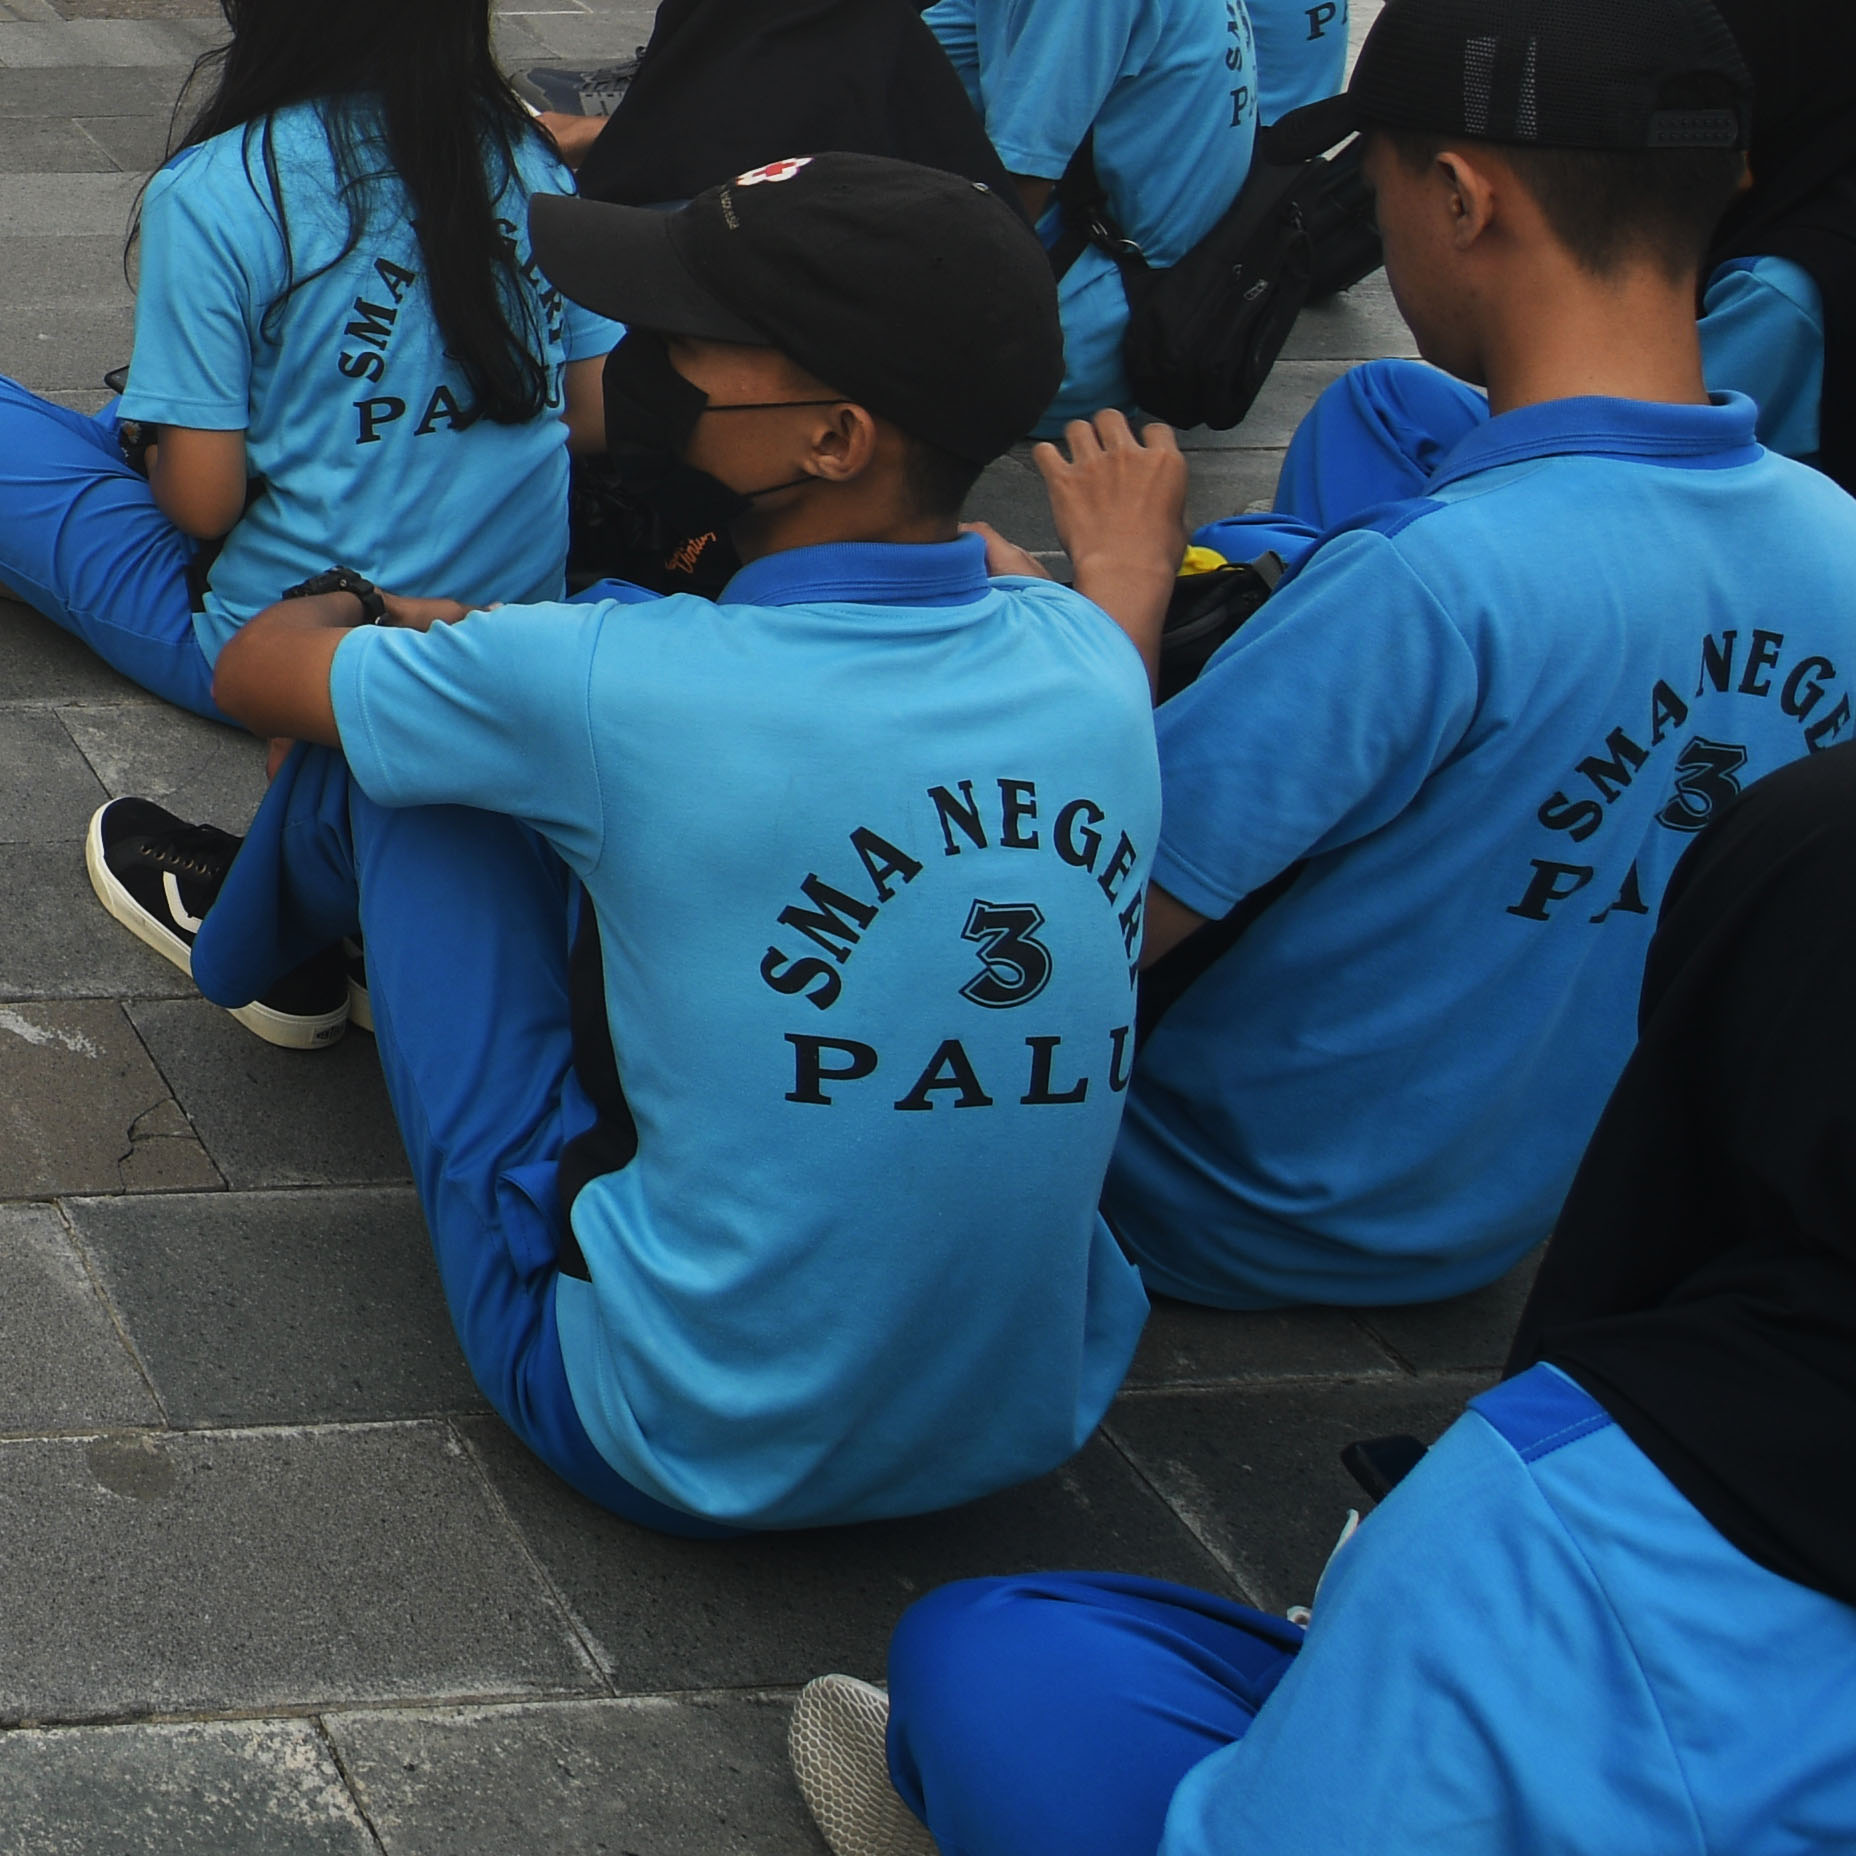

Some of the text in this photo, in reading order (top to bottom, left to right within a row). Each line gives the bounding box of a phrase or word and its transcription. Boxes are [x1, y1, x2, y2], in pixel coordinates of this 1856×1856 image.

[338, 257, 417, 384] SMA
[1538, 629, 1850, 842] SMA NEGE
[1654, 736, 1746, 831] 3
[759, 826, 924, 1011] SMA
[958, 899, 1052, 1009] 3
